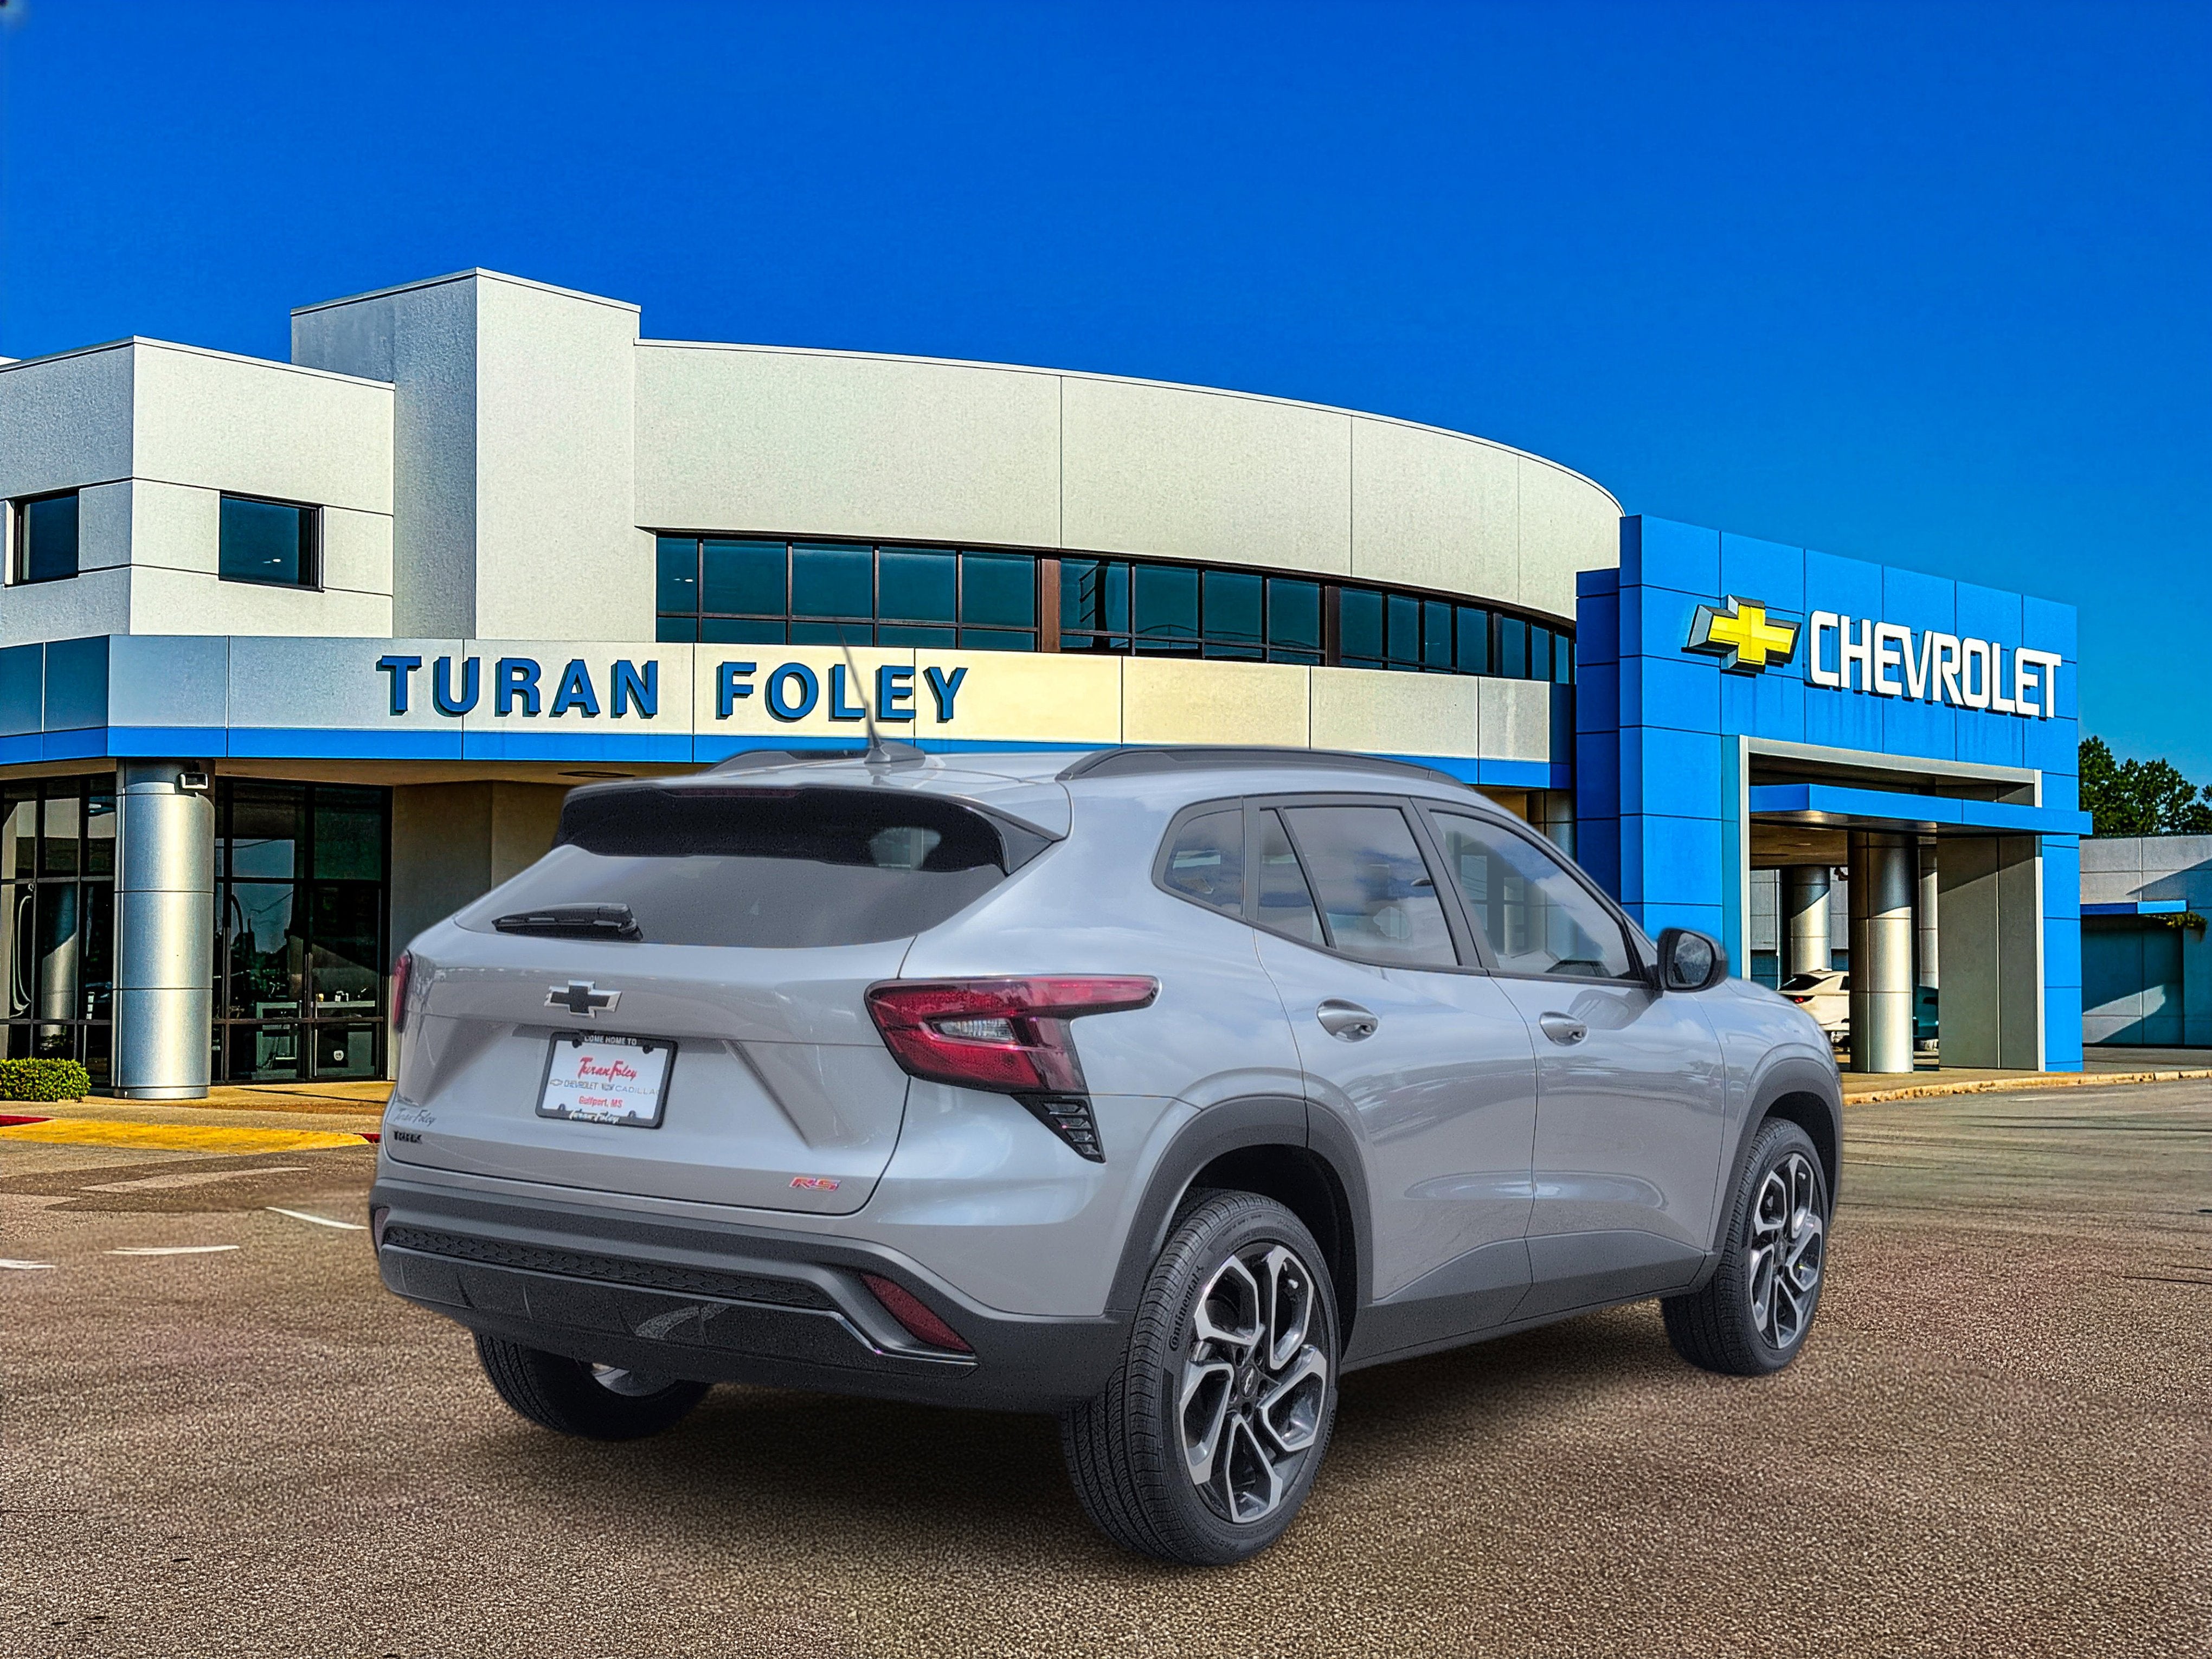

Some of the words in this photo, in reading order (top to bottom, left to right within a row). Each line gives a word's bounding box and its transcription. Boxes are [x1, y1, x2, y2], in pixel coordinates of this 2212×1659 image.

[1810, 610, 2061, 718] CHEVROLET
[376, 655, 658, 719] TURAN
[716, 661, 969, 723] FOLEY
[605, 1036, 626, 1044] HOME
[610, 1099, 623, 1108] MS
[789, 1177, 841, 1192] RS
[1169, 1273, 1200, 1352] Continental
